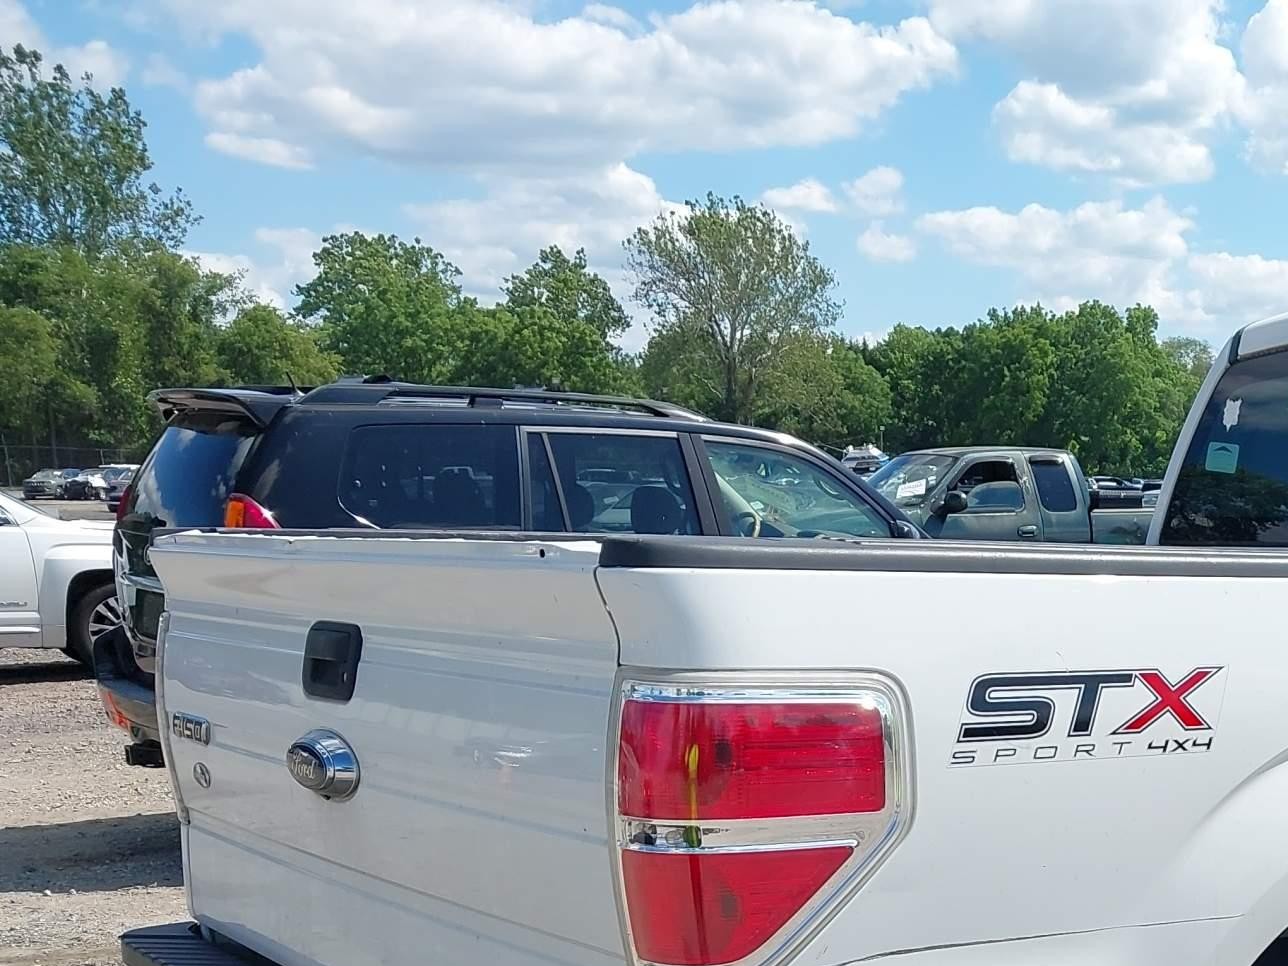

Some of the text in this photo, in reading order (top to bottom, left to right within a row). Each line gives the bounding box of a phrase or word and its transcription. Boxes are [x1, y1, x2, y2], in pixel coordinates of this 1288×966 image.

[956, 666, 1225, 743] STX
[290, 749, 319, 779] Ford
[950, 741, 1133, 765] SPORT
